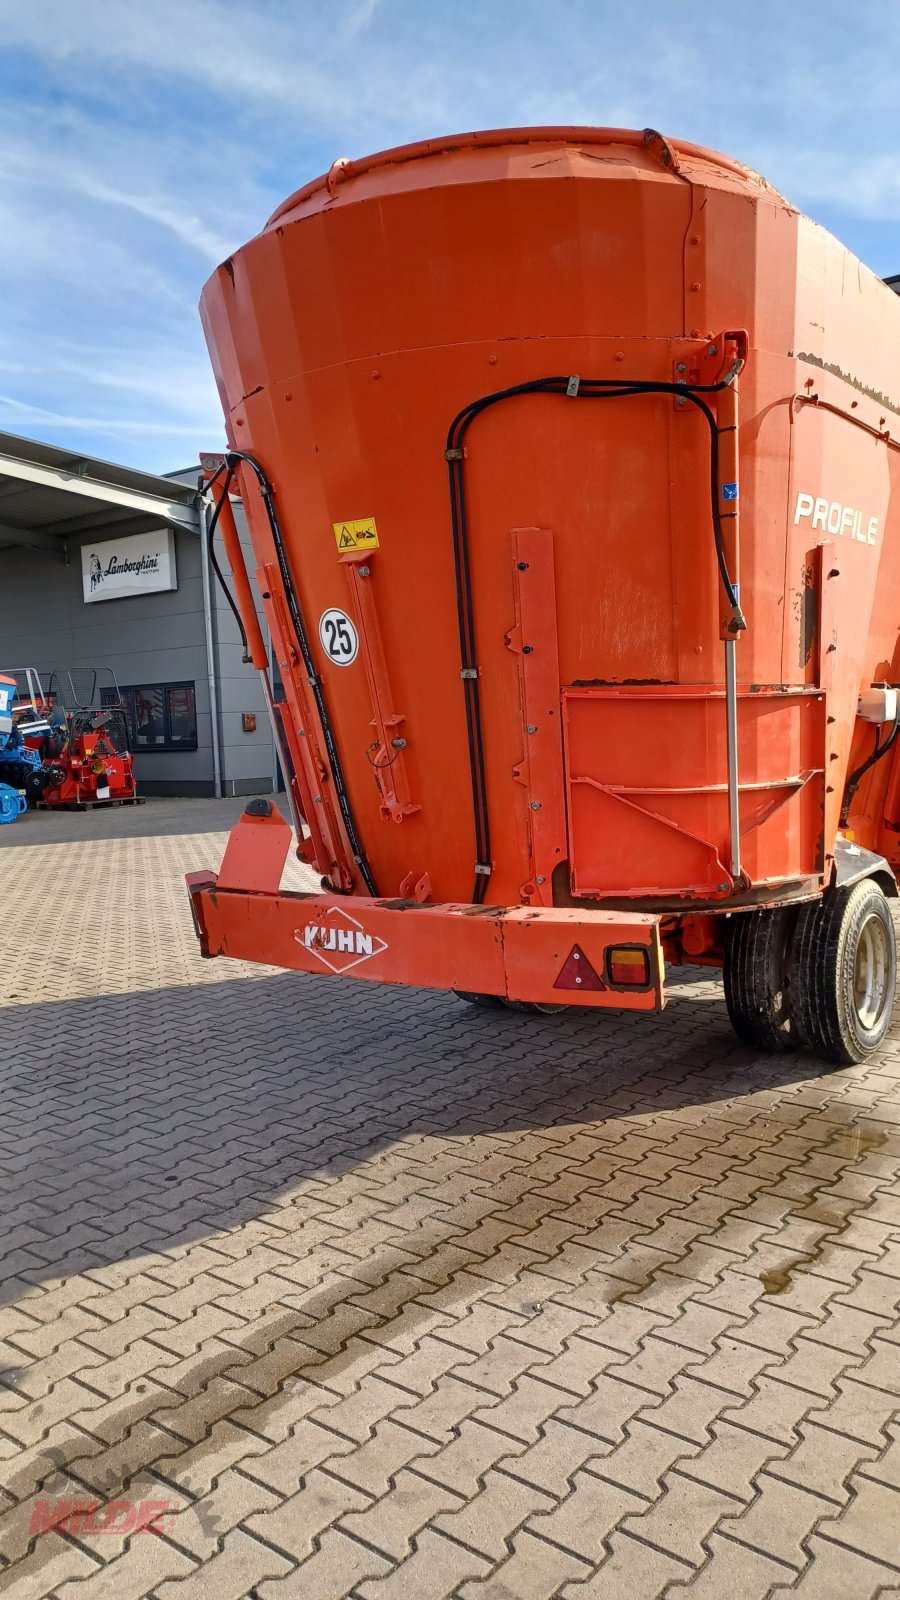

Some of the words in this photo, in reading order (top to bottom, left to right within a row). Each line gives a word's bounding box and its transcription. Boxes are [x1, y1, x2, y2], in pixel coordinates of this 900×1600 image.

[793, 492, 878, 546] PROFILE
[103, 553, 159, 576] Lamborghini
[325, 618, 352, 656] 25
[304, 926, 373, 955] KUHN
